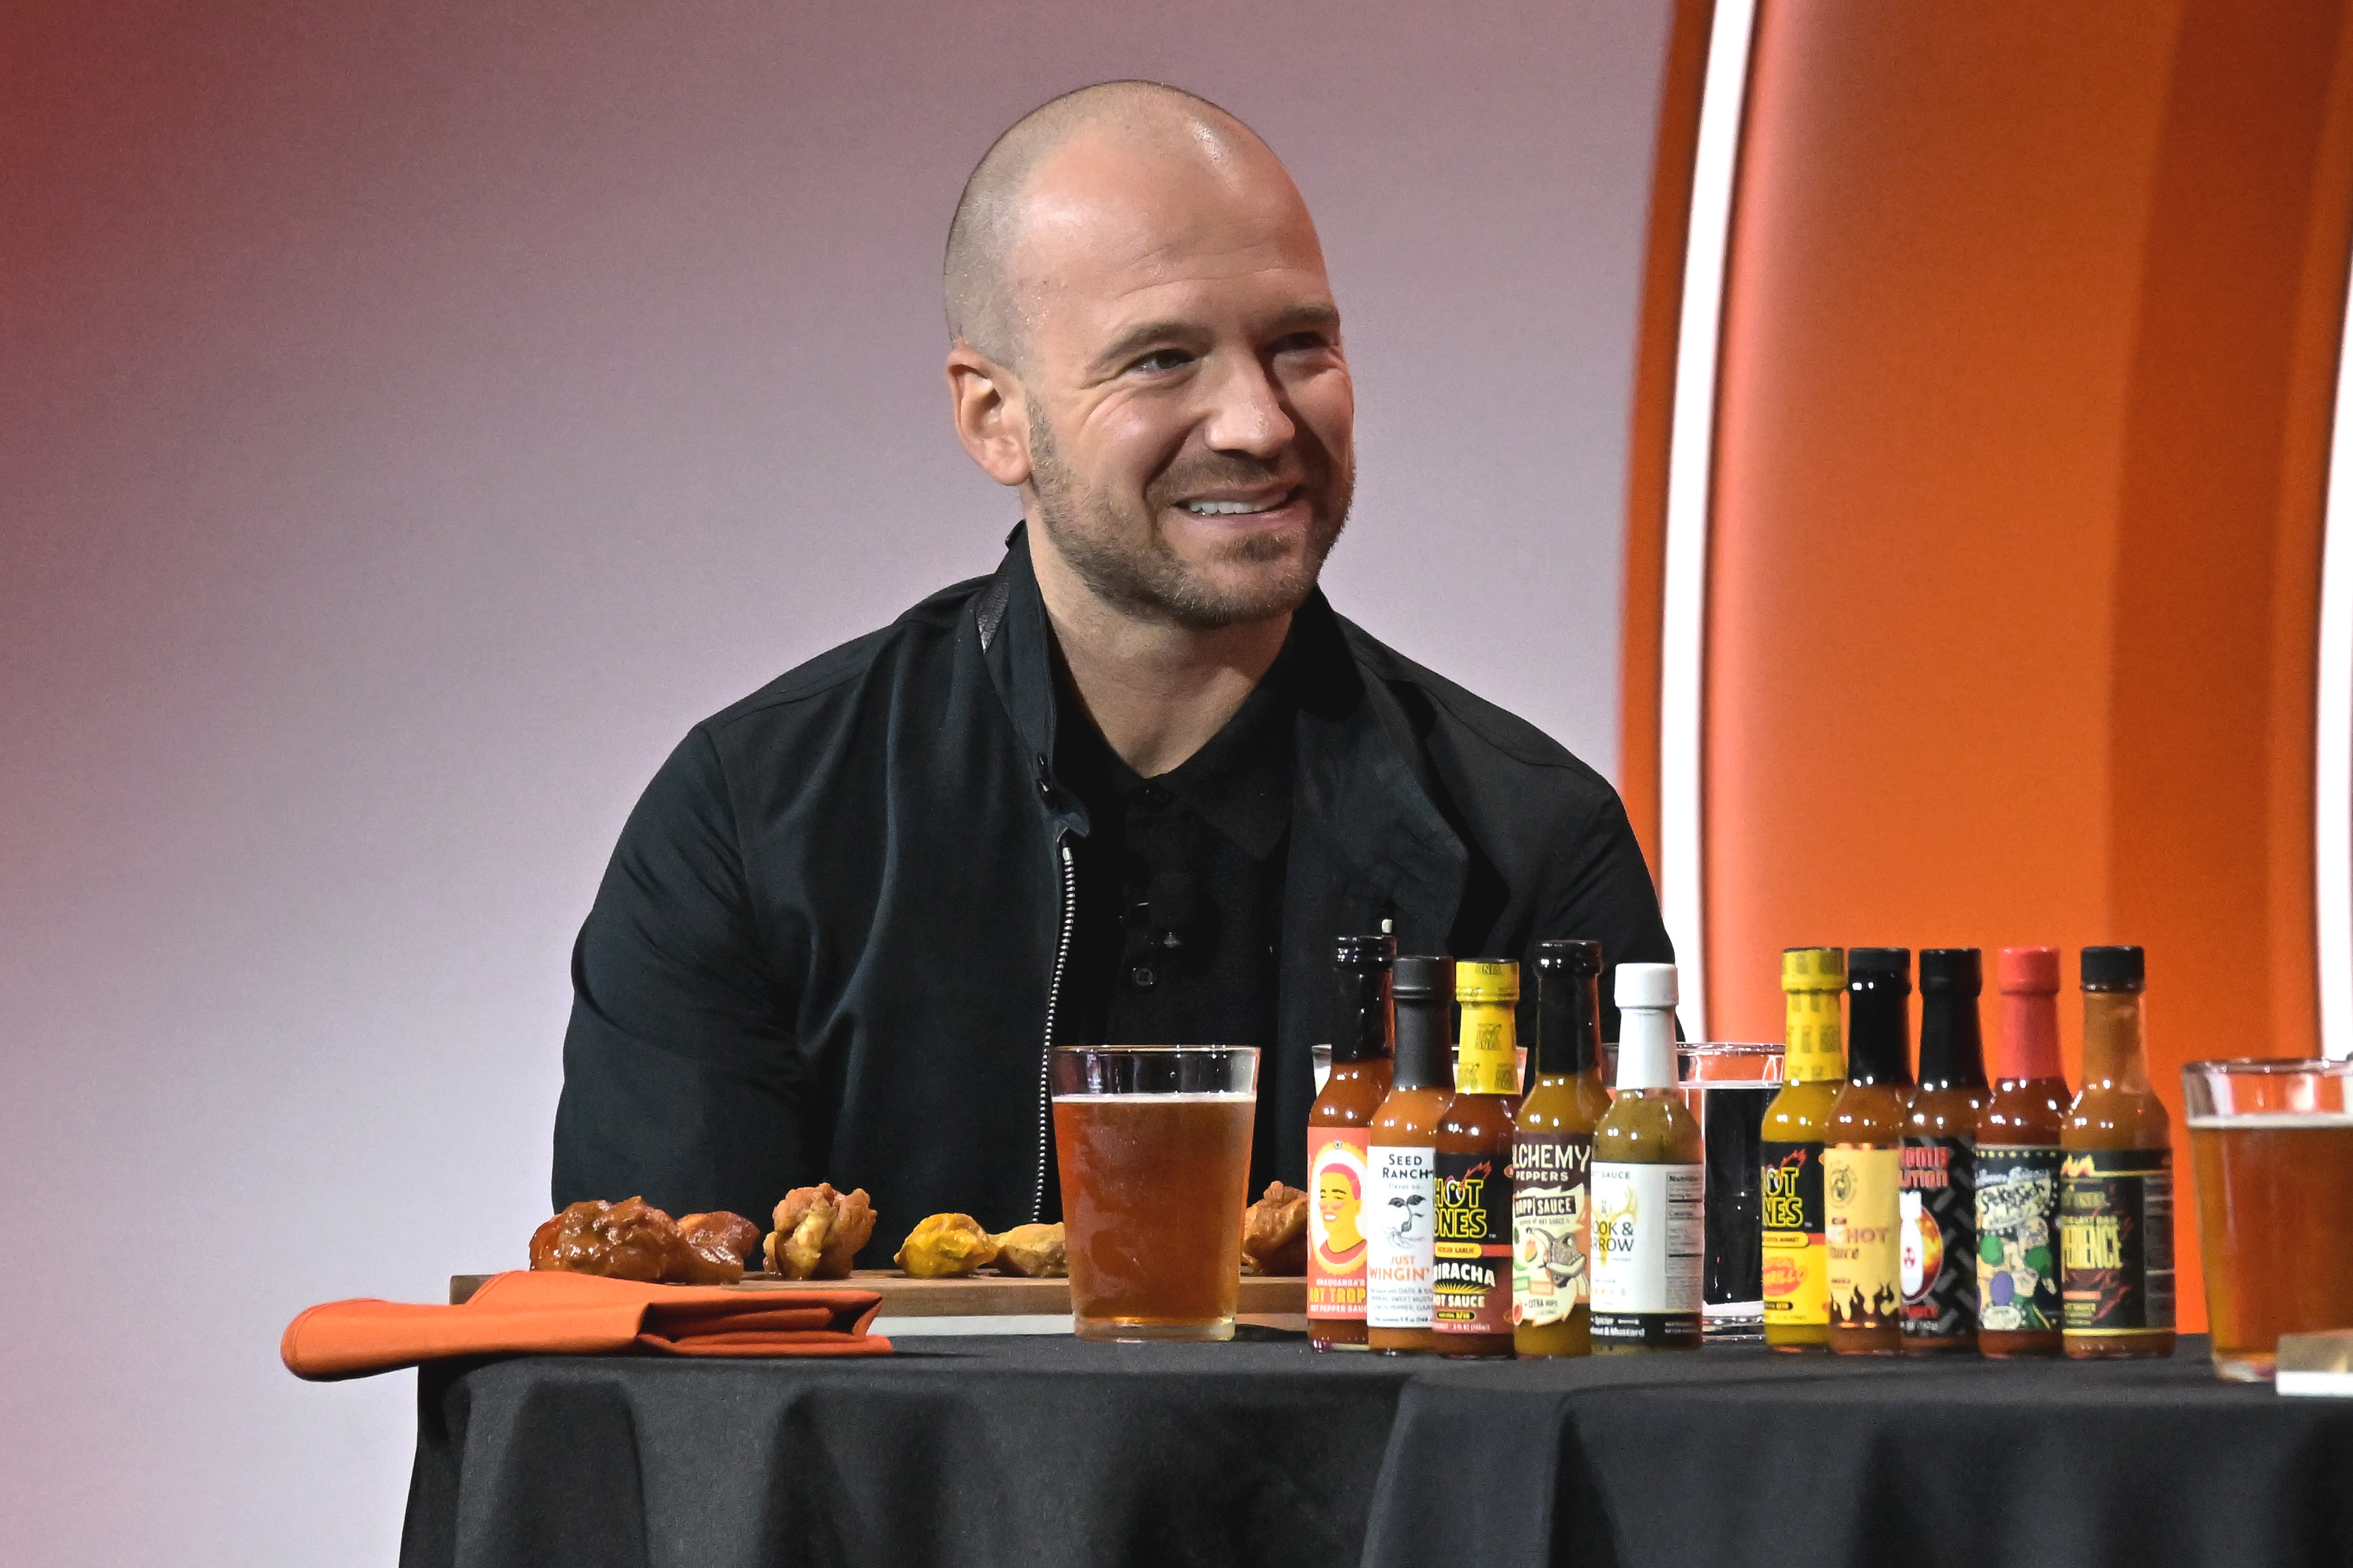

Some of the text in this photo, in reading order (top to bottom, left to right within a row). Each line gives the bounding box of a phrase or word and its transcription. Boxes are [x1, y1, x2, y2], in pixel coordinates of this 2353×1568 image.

[1388, 1153, 1422, 1166] SEED
[1512, 1143, 1591, 1172] LCHEMY
[1382, 1166, 1428, 1179] RANCH
[1515, 1171, 1569, 1182] PEPPERS
[1601, 1171, 1631, 1179] SAUCE
[1537, 1197, 1572, 1215] SAUCE
[1592, 1221, 1634, 1236] OOK &
[1591, 1237, 1634, 1252] RROW
[1391, 1255, 1416, 1265] JUST
[1368, 1266, 1430, 1282] WINGIN'
[1448, 1295, 1485, 1308] SAUCE
